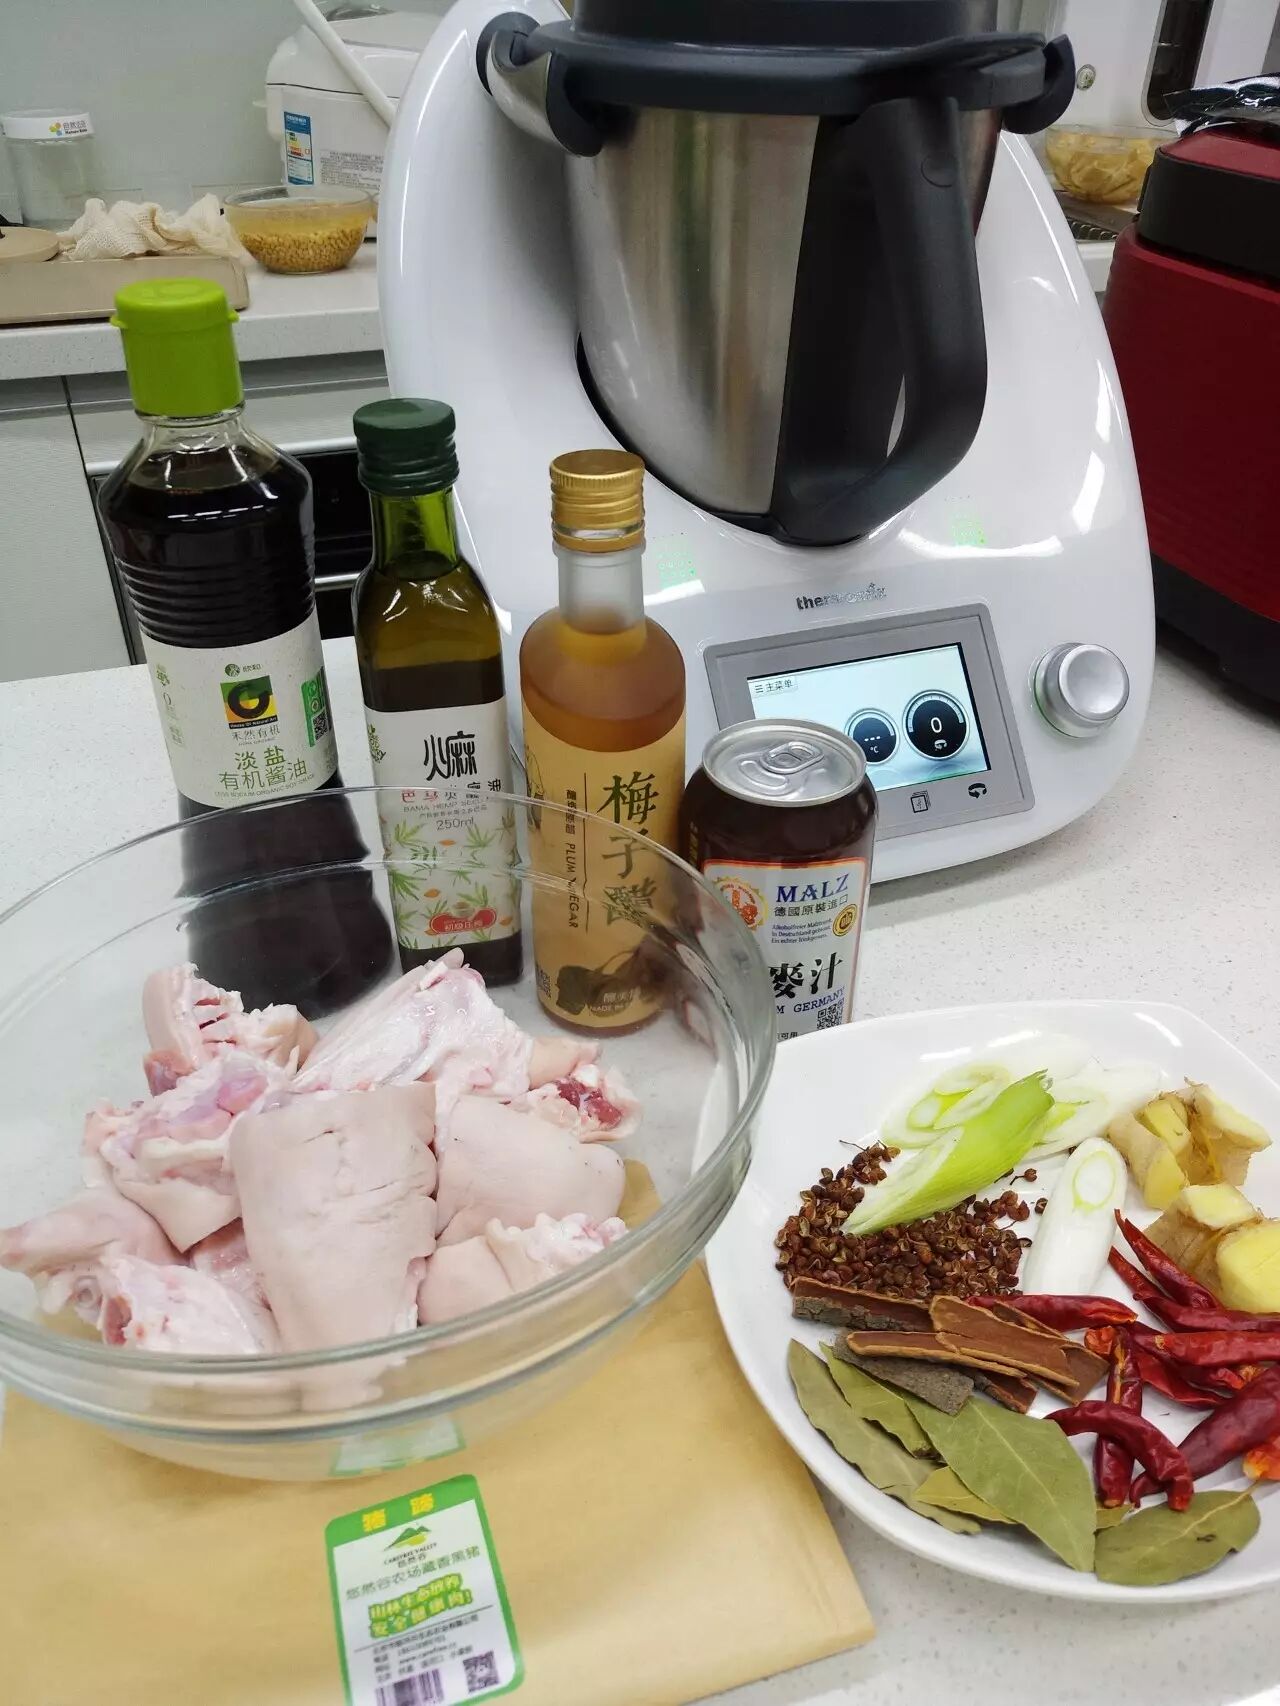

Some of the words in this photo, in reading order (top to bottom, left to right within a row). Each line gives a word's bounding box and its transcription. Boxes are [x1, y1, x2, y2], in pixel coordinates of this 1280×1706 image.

[766, 679, 793, 692] 主菜单
[930, 717, 942, 734] 0
[219, 758, 307, 790] 有机酱油
[436, 817, 474, 831] 250ml
[565, 842, 576, 873] PLUM
[776, 873, 849, 903] MALZ
[568, 877, 579, 929] VEGAR
[774, 894, 848, 917] 德國原裝進口
[793, 986, 845, 1013] GERMANY
